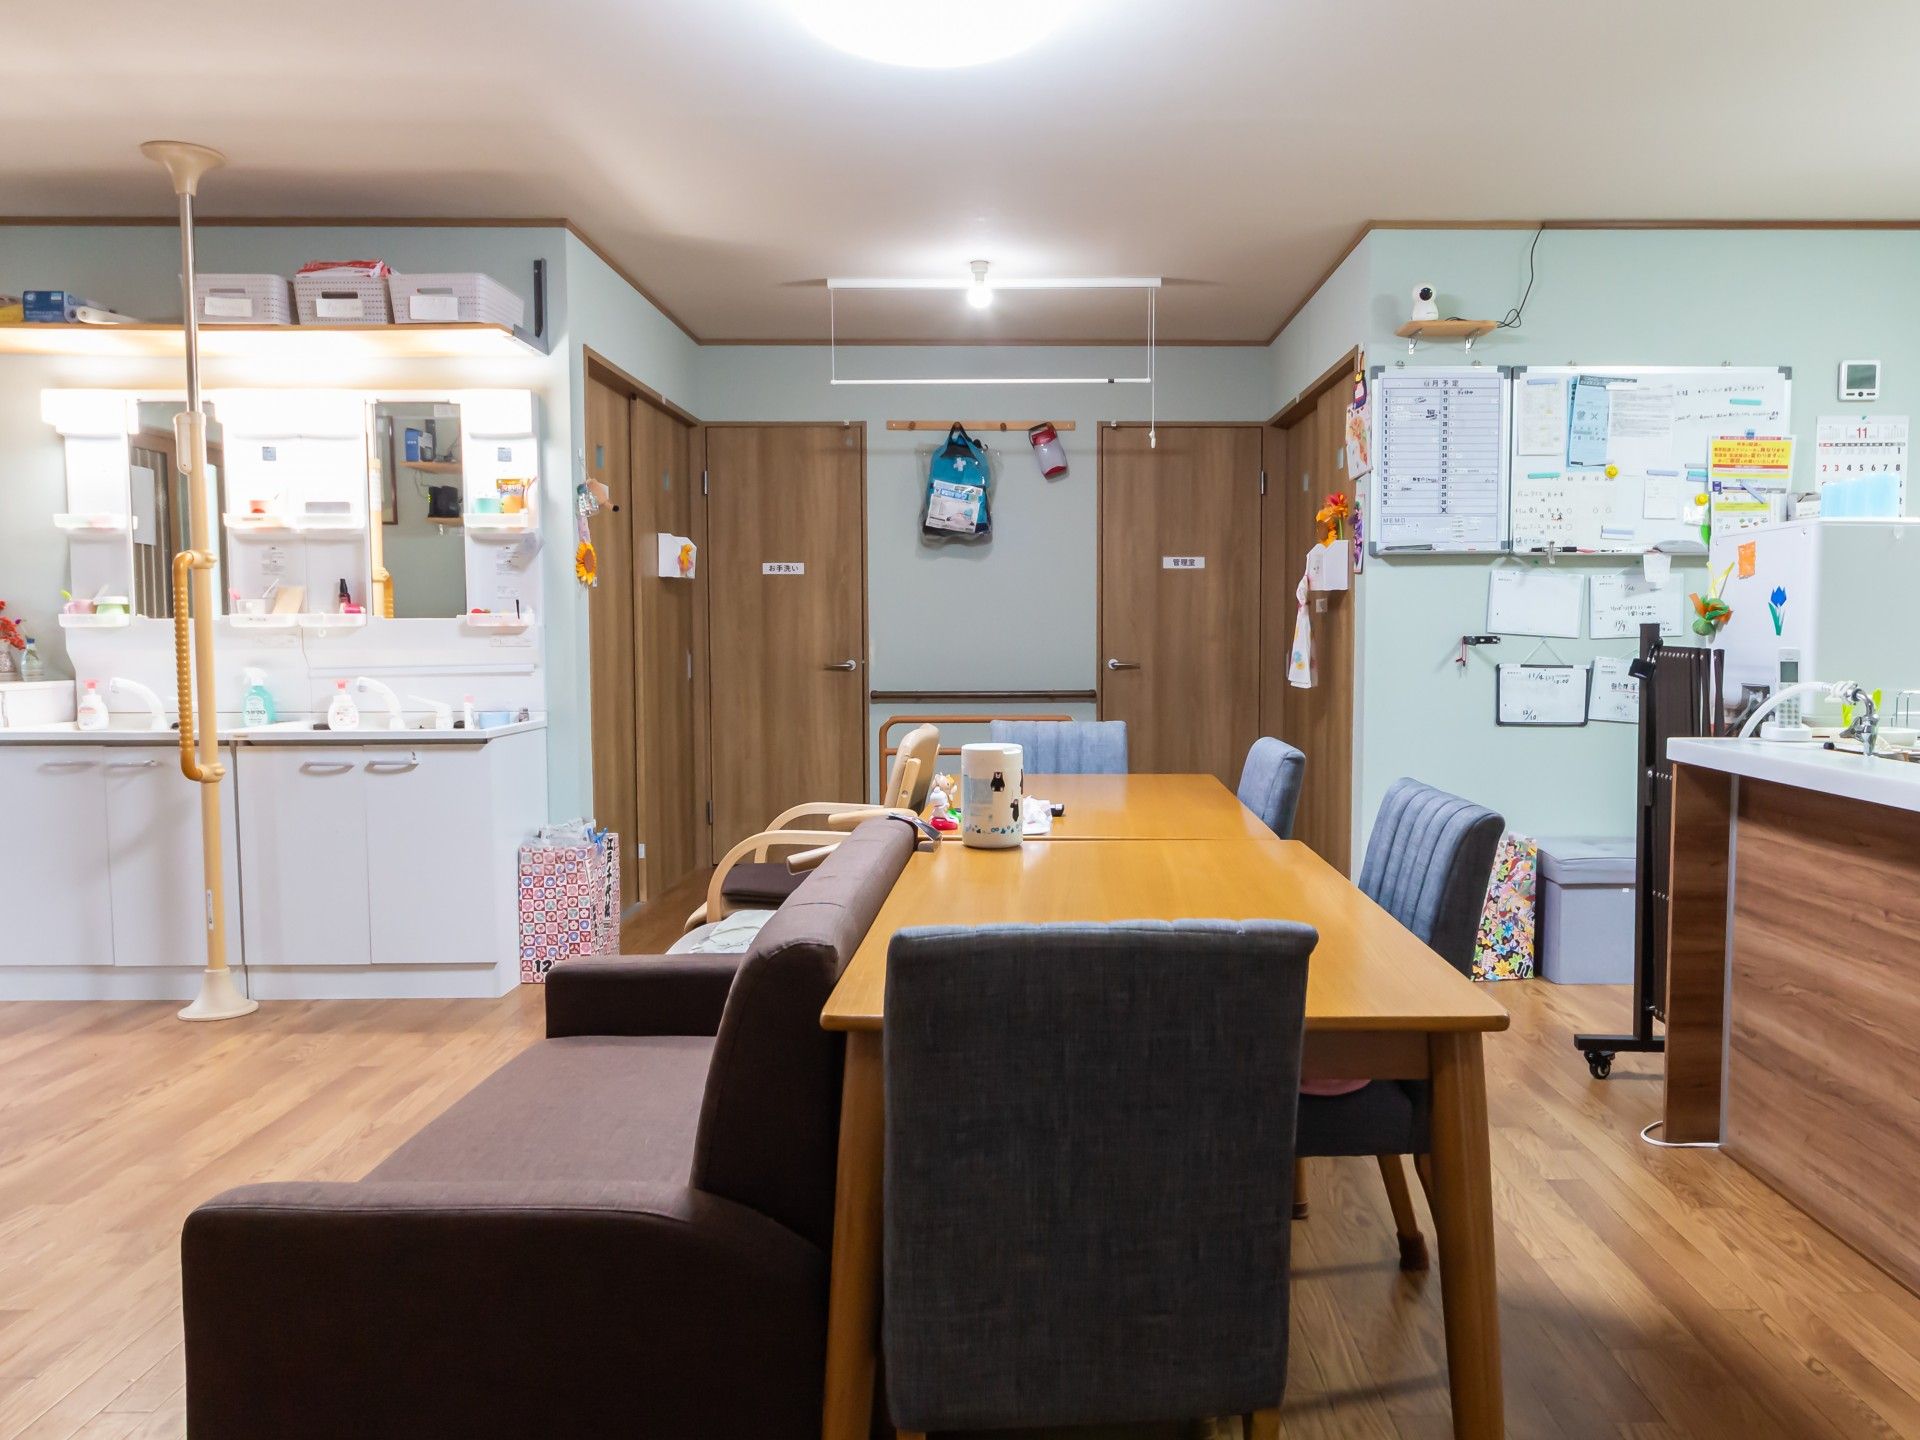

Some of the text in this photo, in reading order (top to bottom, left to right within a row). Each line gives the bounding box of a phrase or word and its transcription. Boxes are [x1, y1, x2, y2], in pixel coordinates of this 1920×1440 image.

[1856, 427, 1868, 439] 11
[1822, 464, 1901, 472] 2 3 4 5 6 7 8
[1172, 558, 1196, 567] 管理室
[768, 564, 799, 573] お手洗い
[534, 959, 553, 974] 12
[1516, 961, 1532, 978] 11
